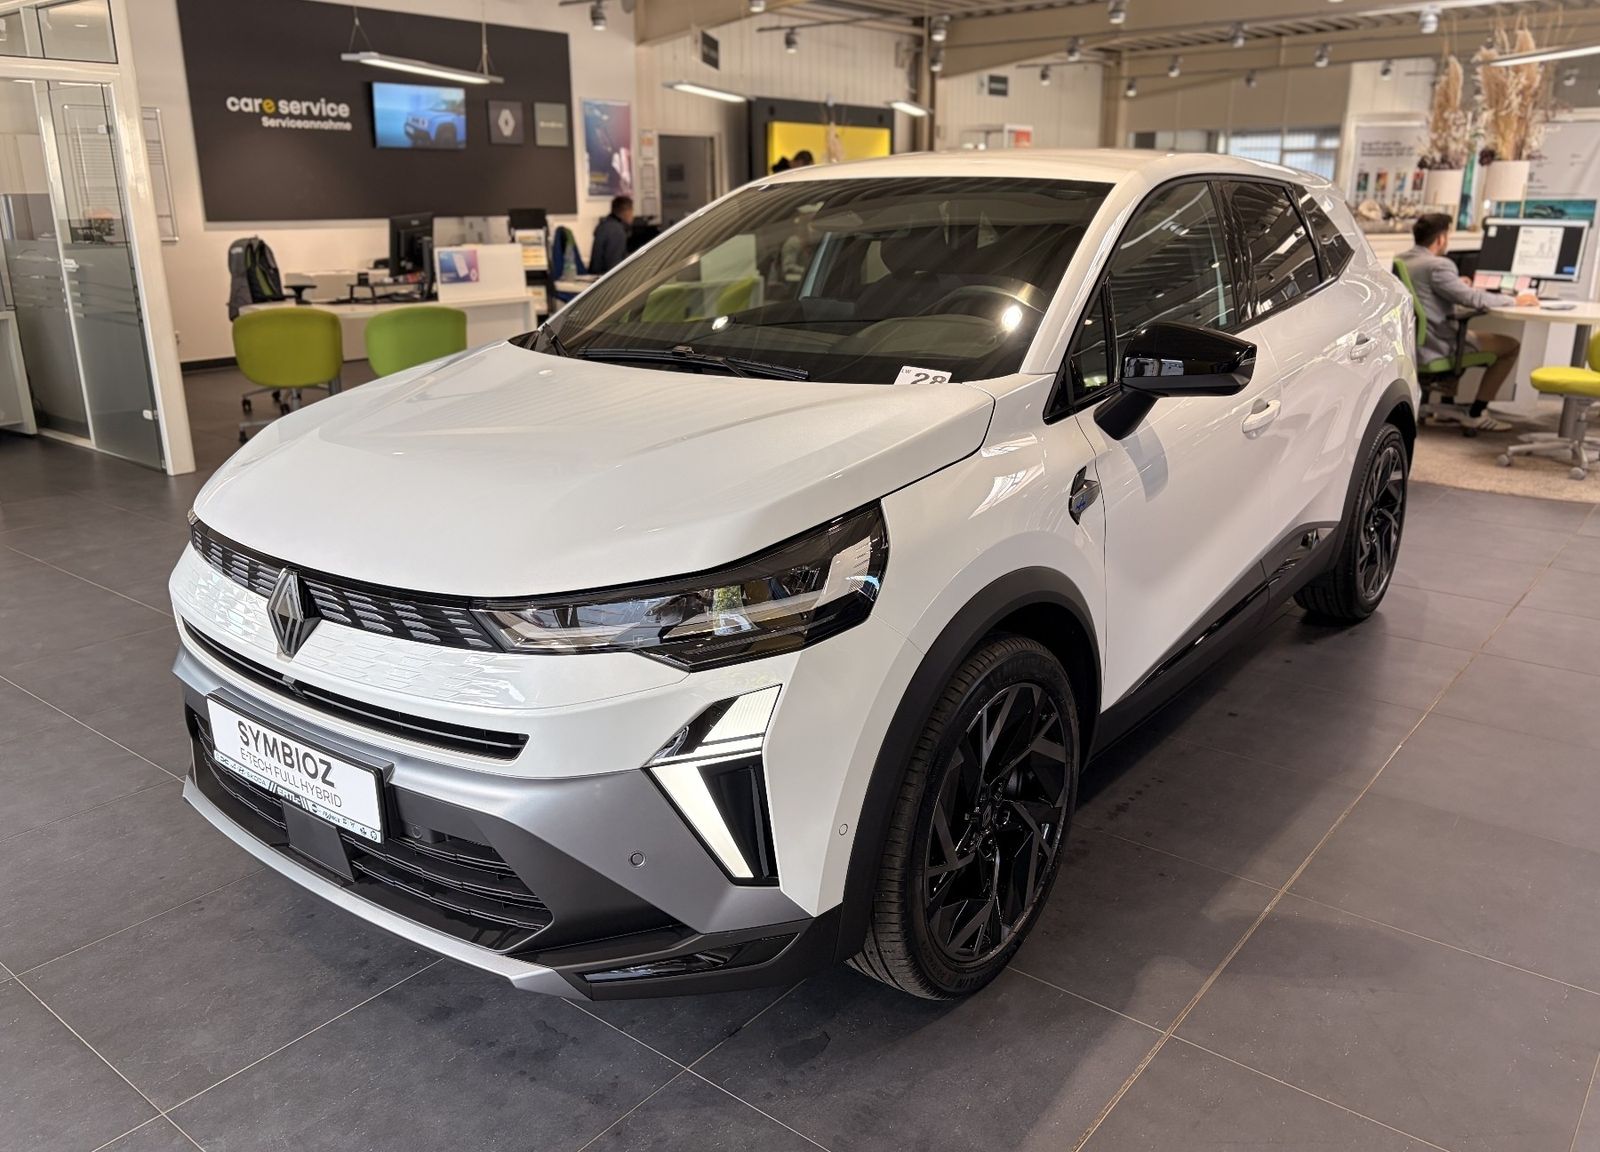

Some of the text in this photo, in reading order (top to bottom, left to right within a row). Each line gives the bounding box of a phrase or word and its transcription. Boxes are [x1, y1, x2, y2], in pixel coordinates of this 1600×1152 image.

[226, 96, 350, 117] care service
[261, 116, 352, 131] Serviceannahme
[237, 720, 335, 788] SYMBIOZ
[240, 747, 273, 776] E-TECH
[274, 765, 300, 789] FULL
[300, 778, 343, 808] HYBRID
